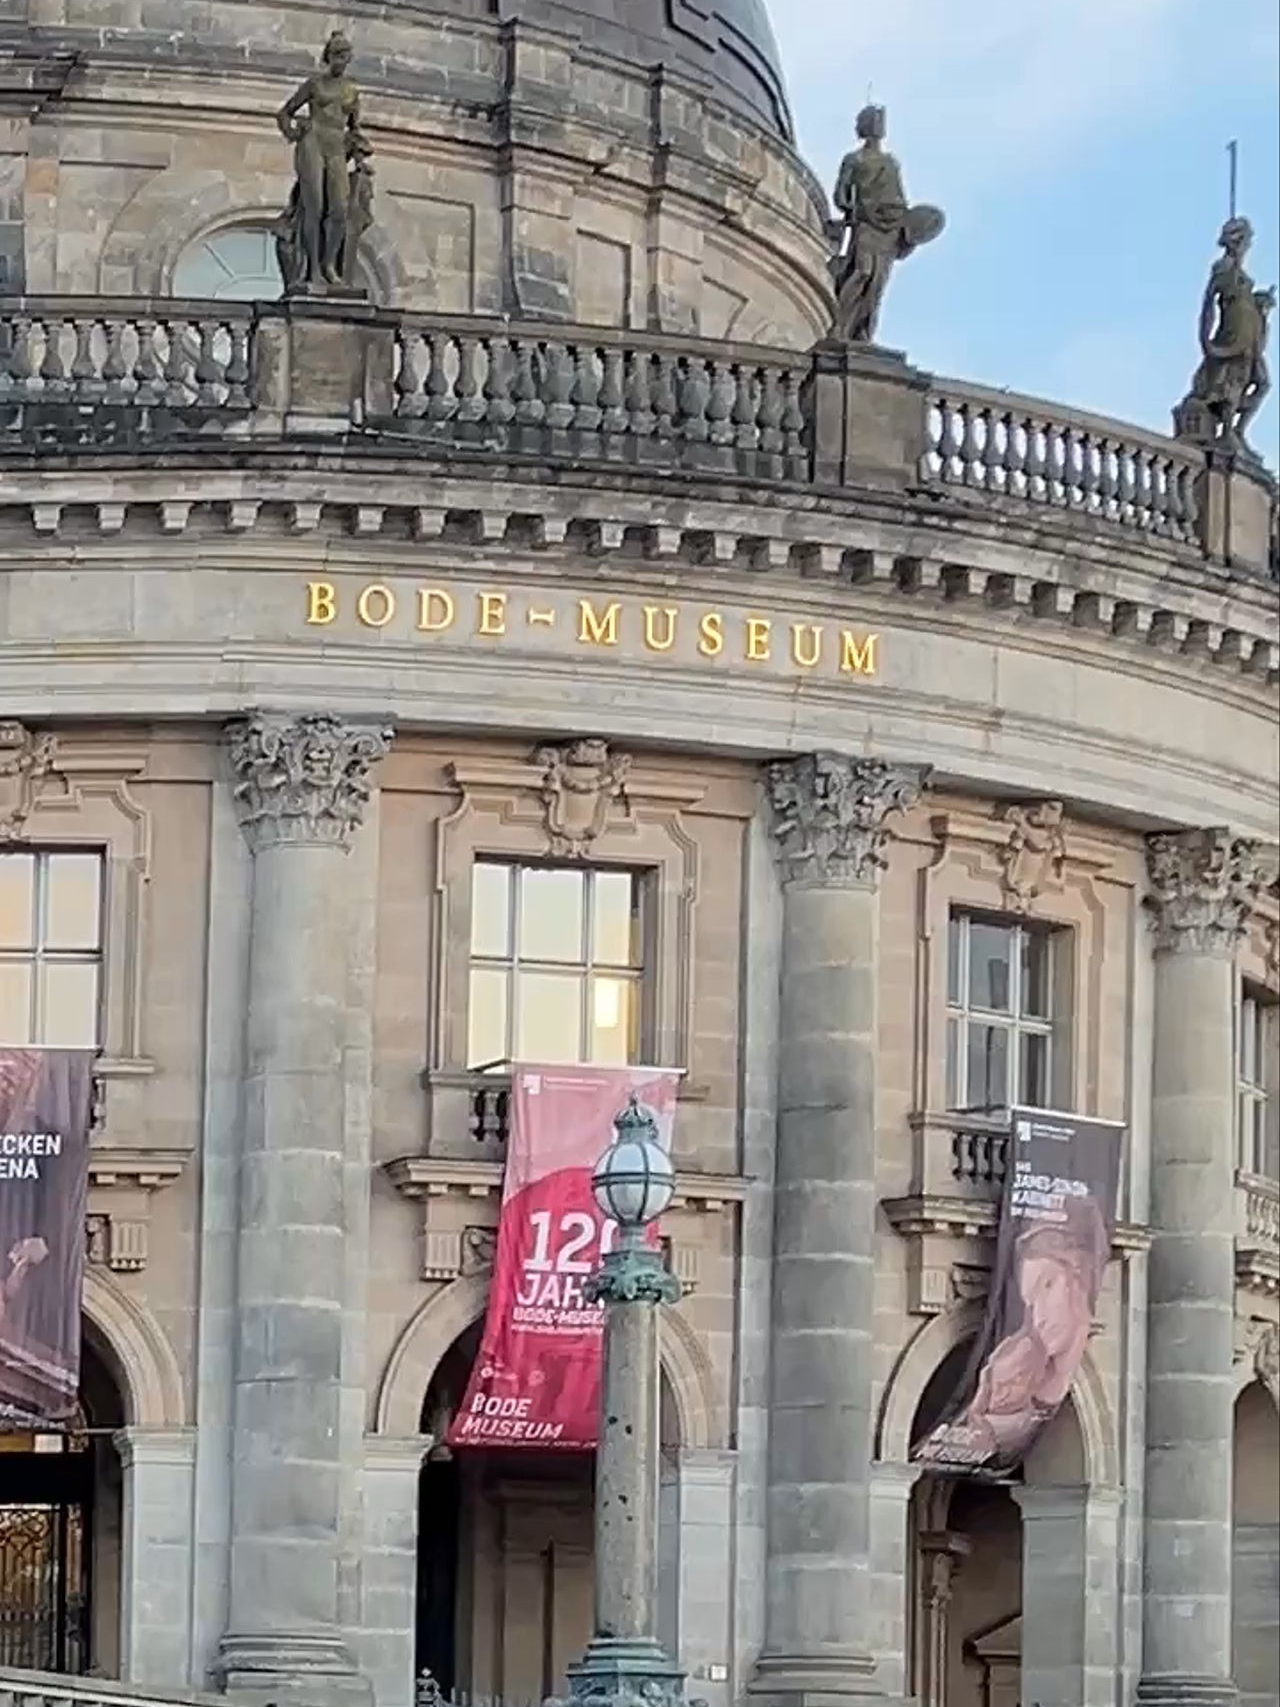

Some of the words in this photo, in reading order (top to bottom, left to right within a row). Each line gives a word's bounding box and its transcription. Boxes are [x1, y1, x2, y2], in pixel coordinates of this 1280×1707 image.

[306, 581, 880, 676] BODE-MUSEUM
[470, 1392, 533, 1418] BODE
[461, 1415, 564, 1439] MUSEUM
